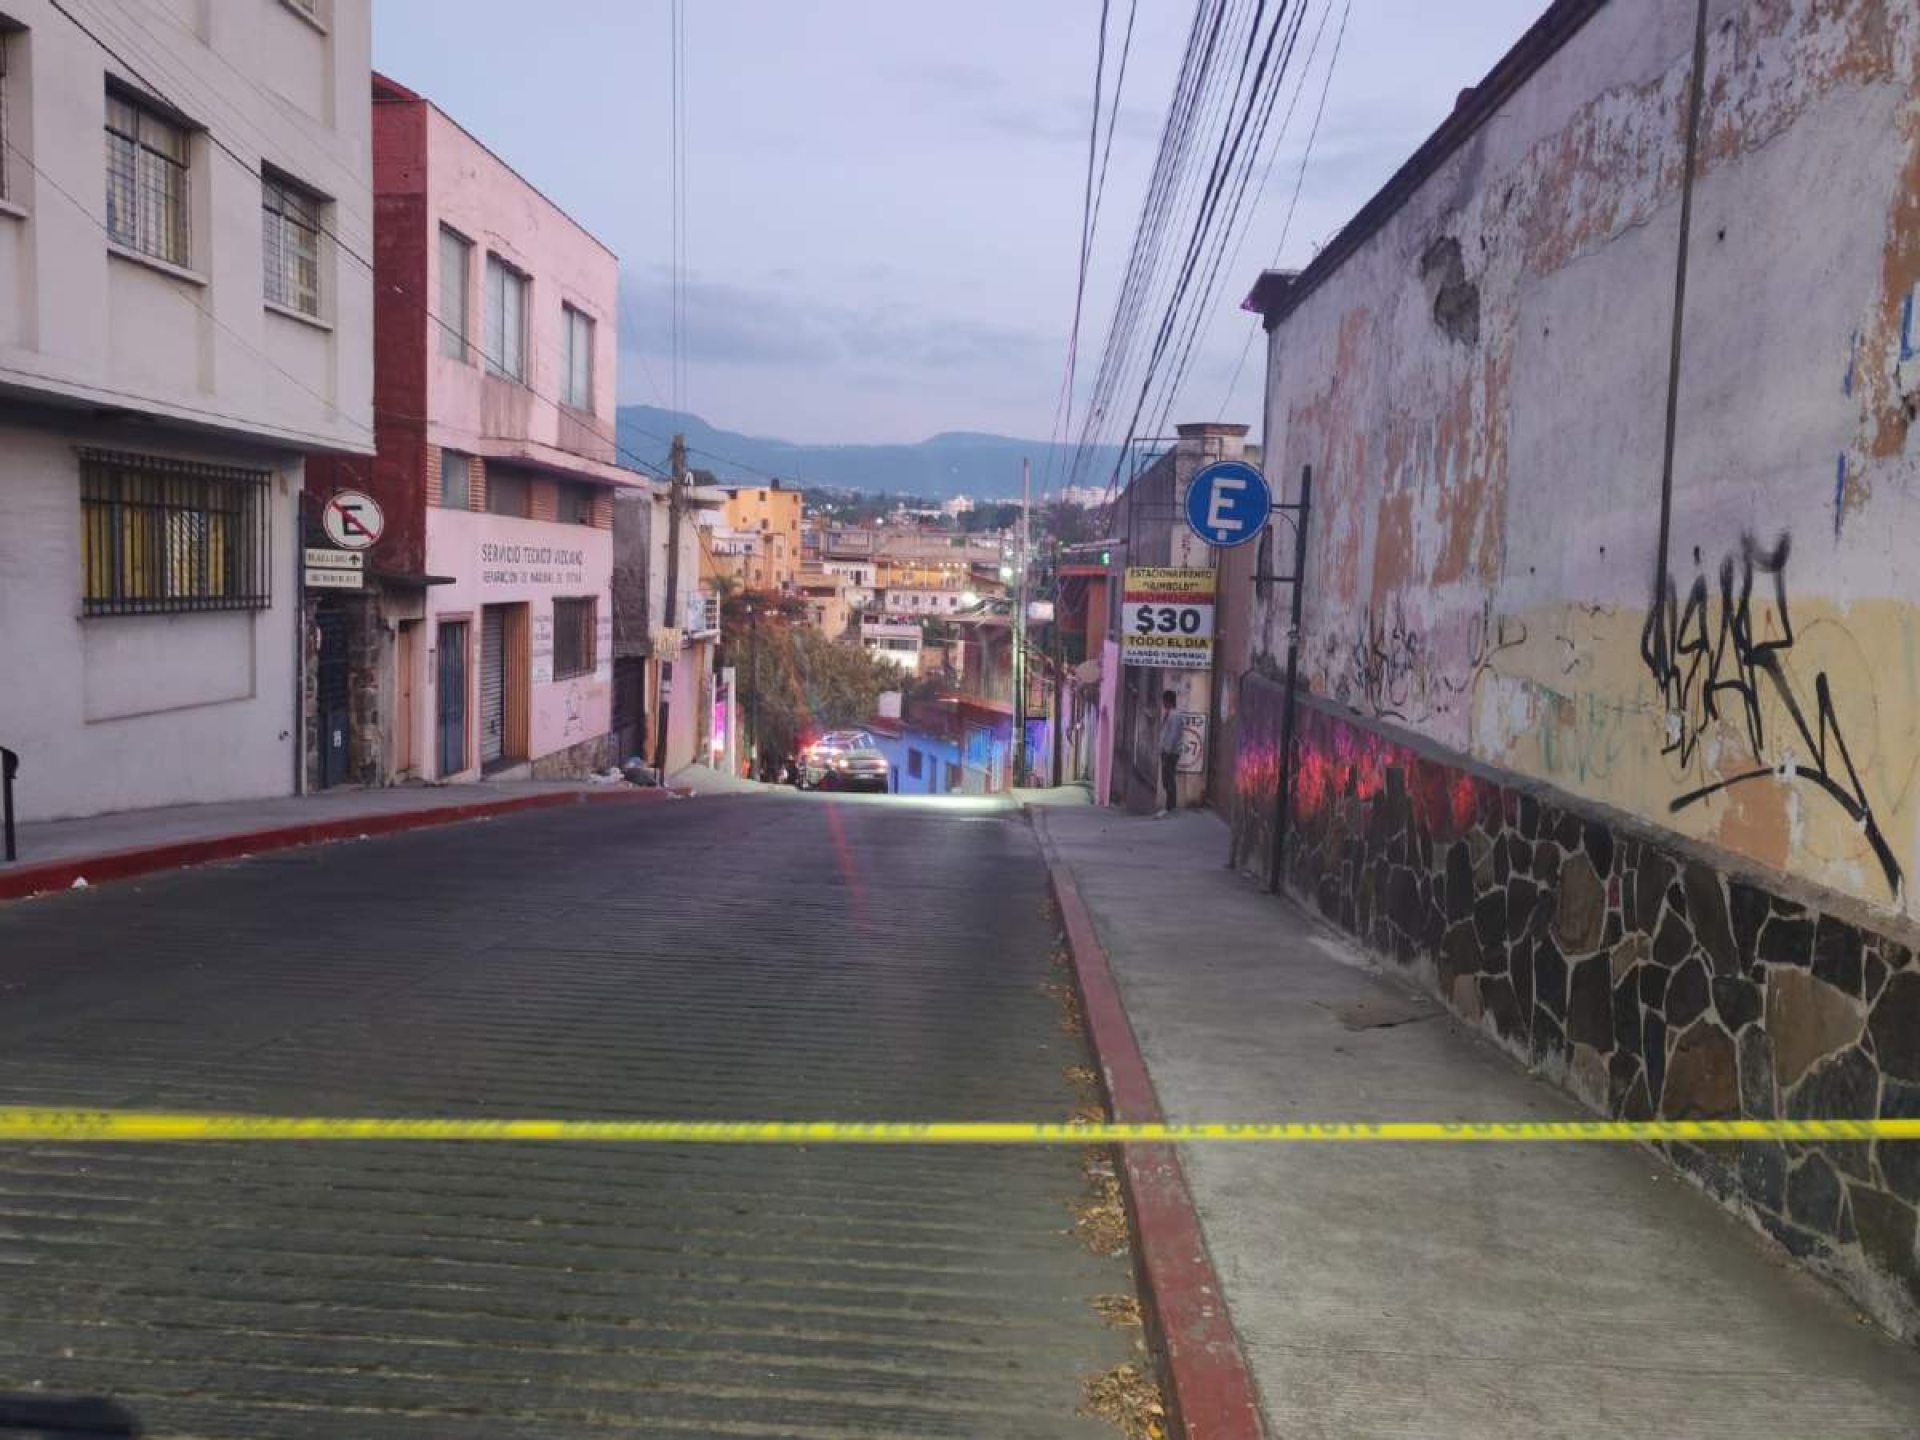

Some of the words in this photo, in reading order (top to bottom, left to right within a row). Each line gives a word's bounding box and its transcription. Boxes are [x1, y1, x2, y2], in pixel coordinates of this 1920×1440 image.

[1207, 477, 1247, 530] E
[481, 543, 521, 564] SERVICIO
[1130, 568, 1212, 579] ESTACIONAMIENTO
[1135, 604, 1201, 635] $30
[1129, 635, 1165, 647] TODO
[1167, 638, 1183, 648] EL
